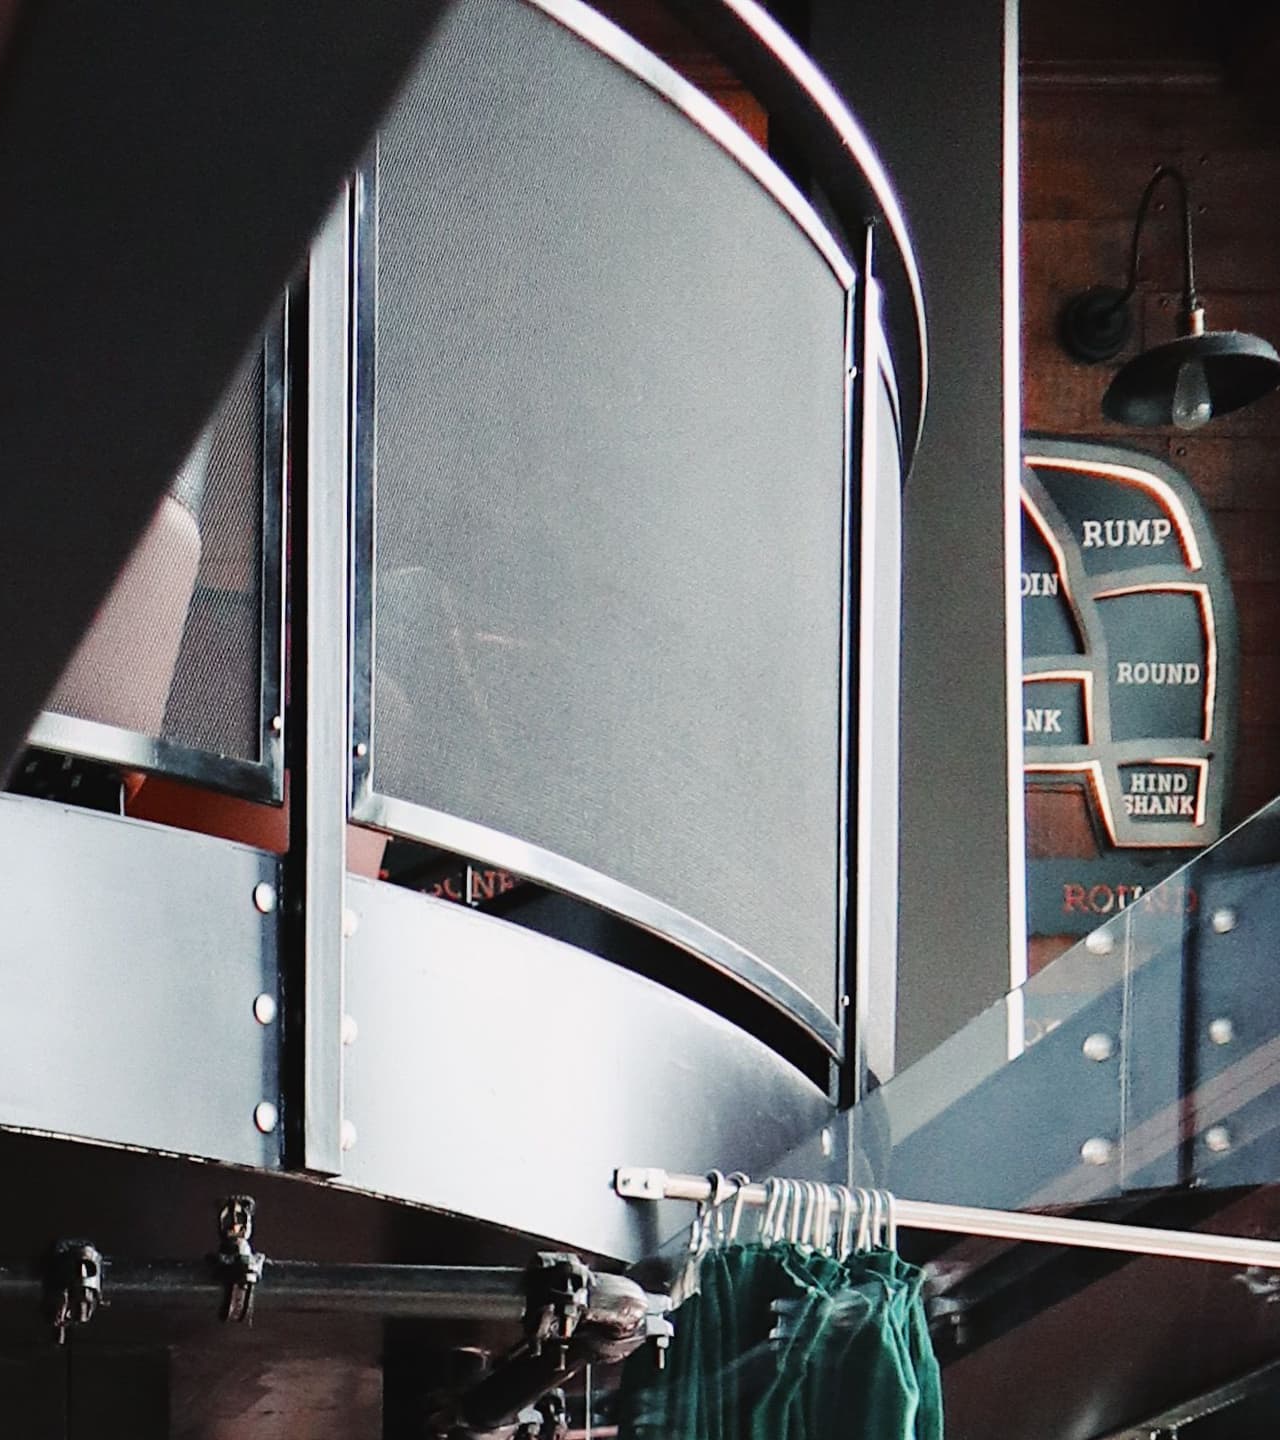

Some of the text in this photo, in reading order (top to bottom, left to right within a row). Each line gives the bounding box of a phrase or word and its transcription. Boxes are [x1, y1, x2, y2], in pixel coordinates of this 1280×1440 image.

[1083, 519, 1172, 548] RUMP
[1117, 661, 1200, 685] ROUND
[1131, 773, 1188, 795] HIND
[1124, 794, 1195, 816] SHANK
